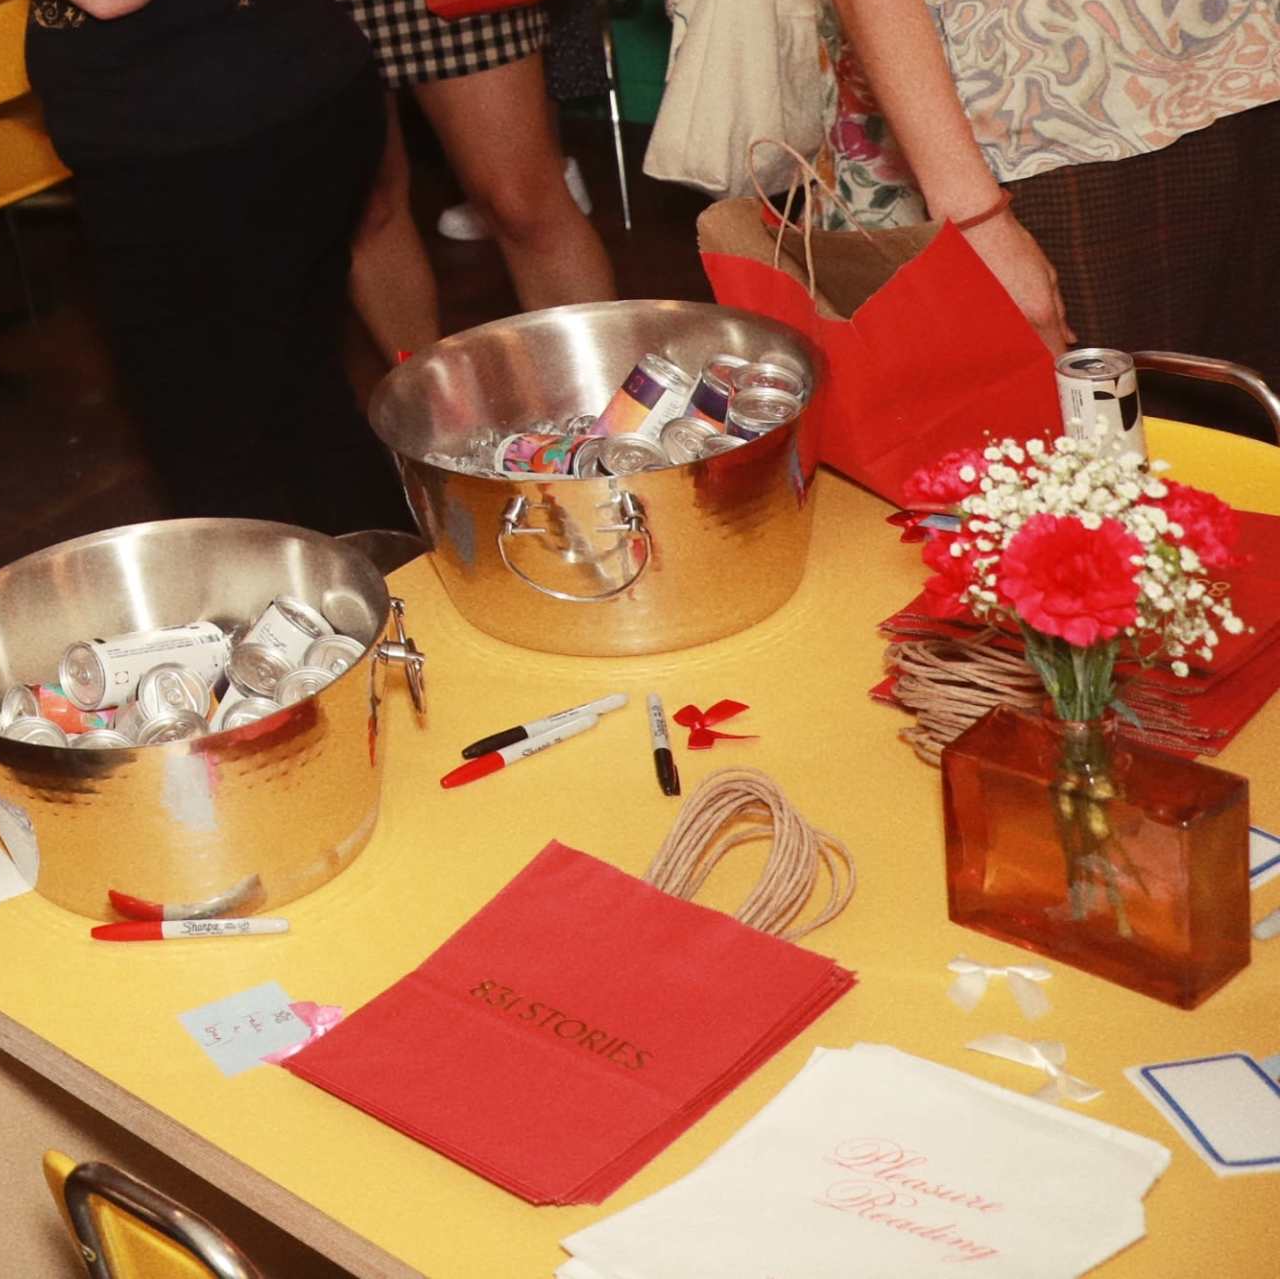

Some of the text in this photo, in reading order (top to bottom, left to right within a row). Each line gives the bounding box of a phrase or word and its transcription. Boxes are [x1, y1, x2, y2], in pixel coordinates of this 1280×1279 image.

[469, 980, 655, 1071] 831 STORIES
[822, 1137, 1006, 1212] Pleasure
[813, 1179, 999, 1264] Reading
